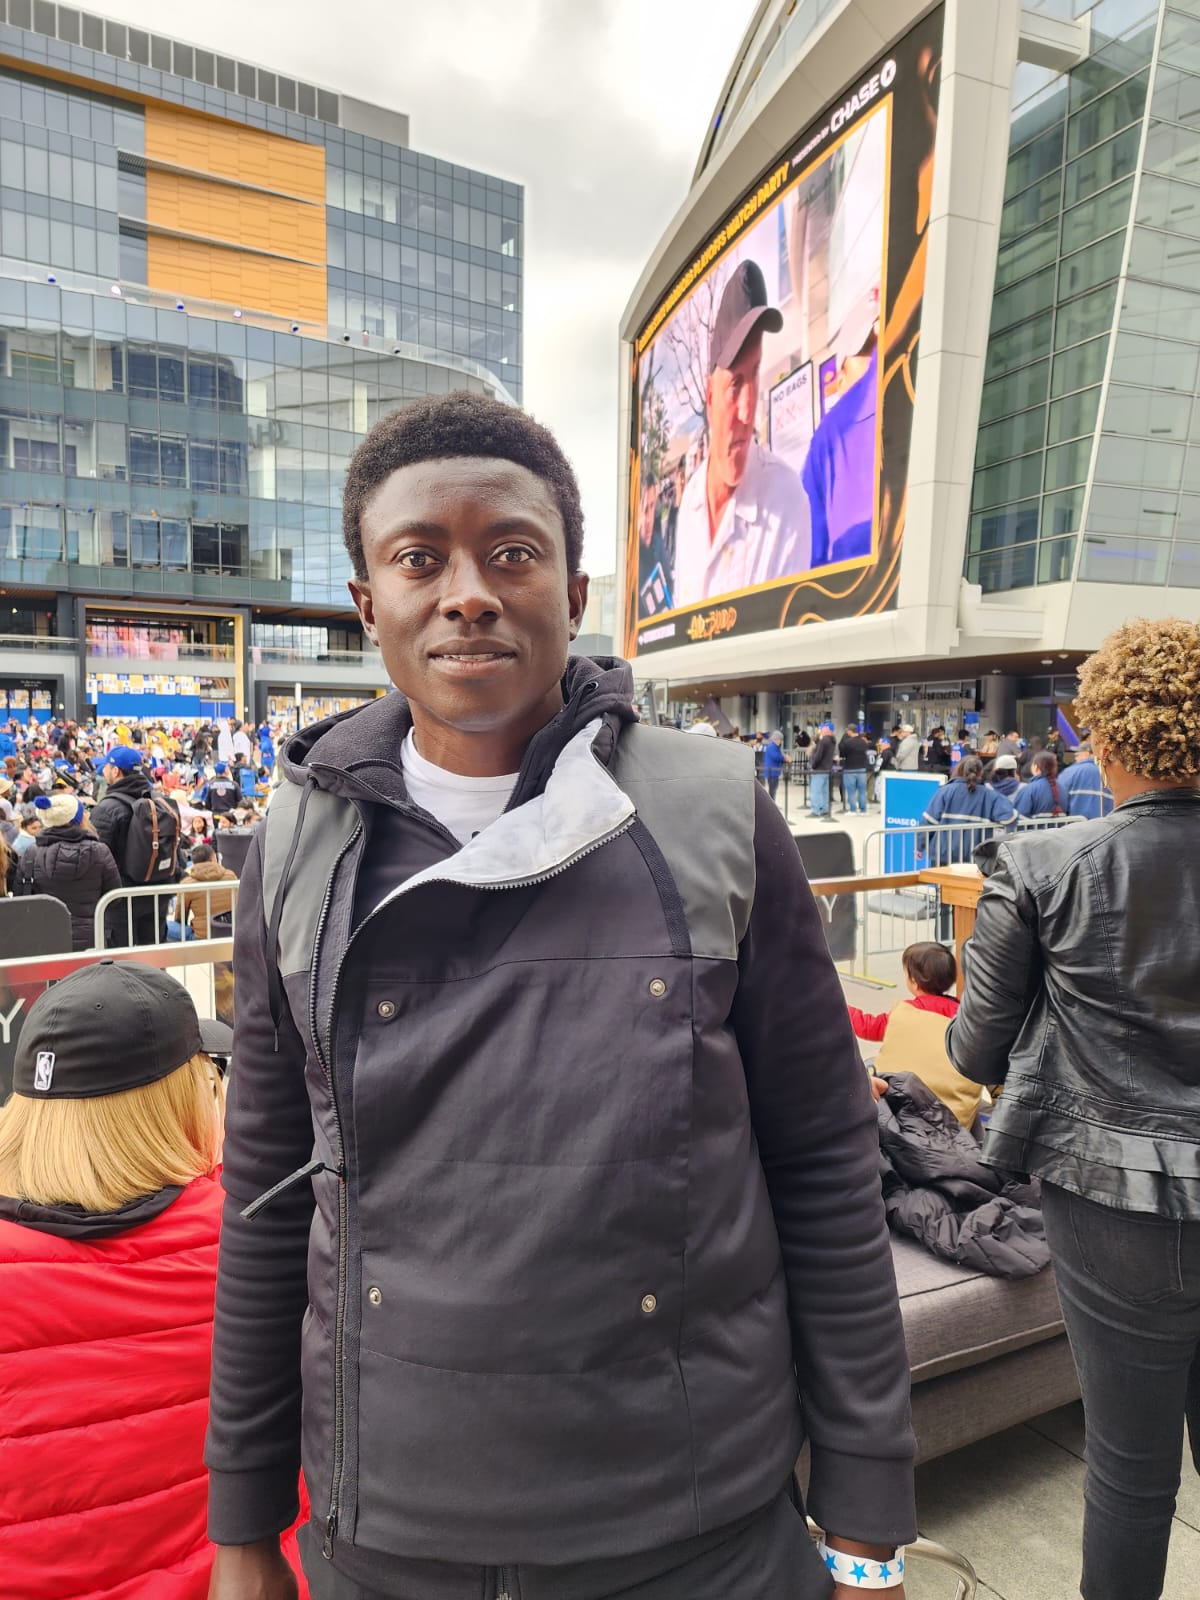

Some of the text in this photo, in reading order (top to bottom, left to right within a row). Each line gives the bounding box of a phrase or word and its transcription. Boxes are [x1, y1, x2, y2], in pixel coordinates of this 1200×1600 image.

[830, 74, 880, 133] CHASE
[757, 161, 790, 208] PARTY
[887, 816, 910, 826] CHASE
